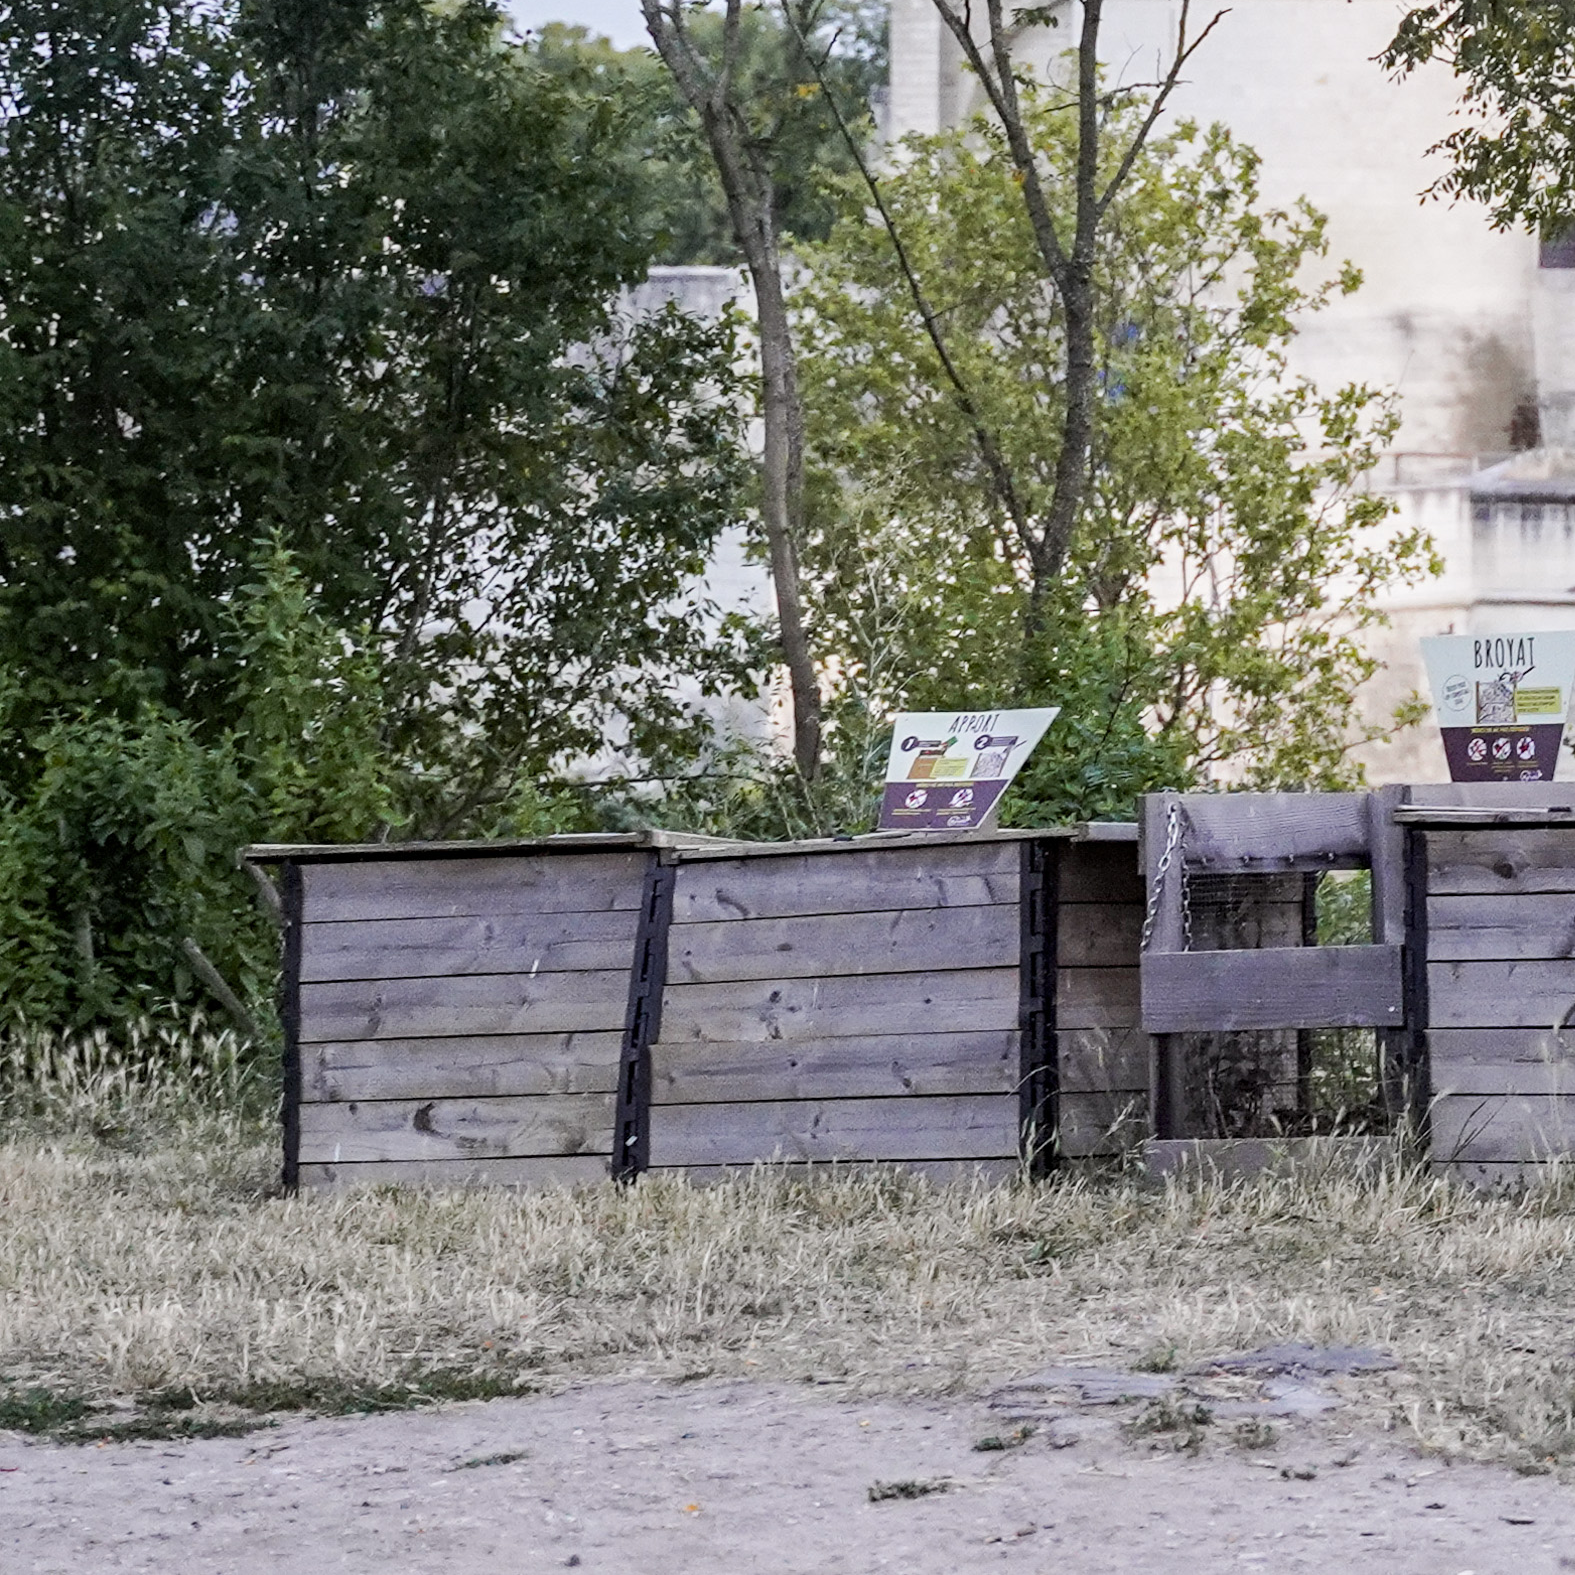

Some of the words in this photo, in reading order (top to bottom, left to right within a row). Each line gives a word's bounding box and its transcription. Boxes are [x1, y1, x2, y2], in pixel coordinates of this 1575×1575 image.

[1473, 637, 1535, 669] BROYAT
[948, 713, 1001, 733] APPORT
[976, 735, 988, 750] 2
